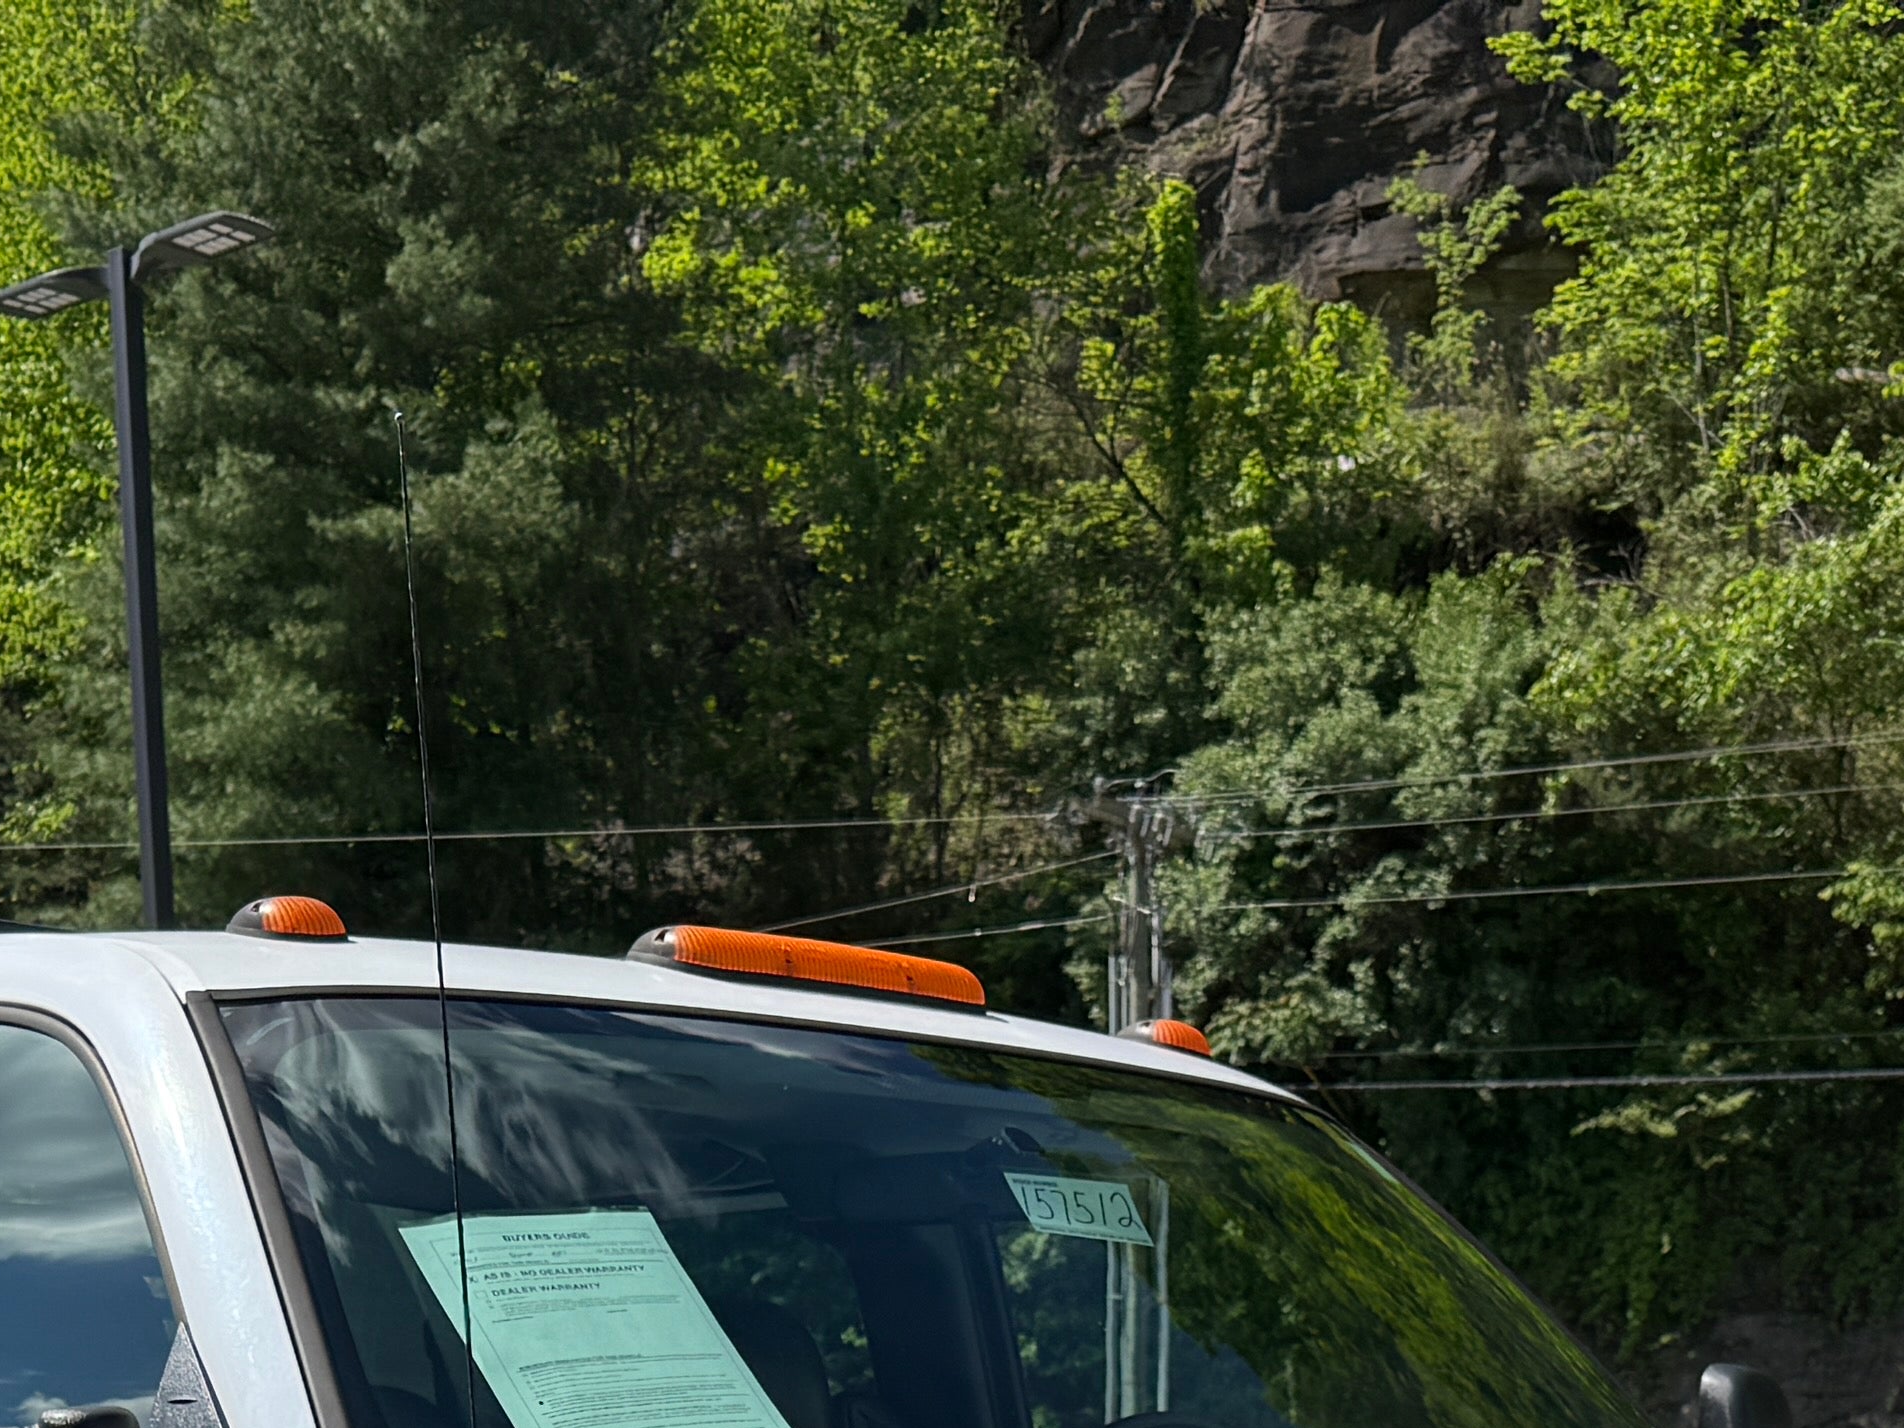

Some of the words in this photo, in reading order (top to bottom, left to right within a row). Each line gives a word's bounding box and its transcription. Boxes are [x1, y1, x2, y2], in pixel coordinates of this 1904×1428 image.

[1021, 1186, 1143, 1231] 157512
[502, 1232, 550, 1243] BUYERS
[553, 1231, 591, 1240] GUIDE
[483, 1272, 499, 1281] AS
[500, 1271, 512, 1280] IS
[520, 1269, 537, 1278] NO
[539, 1266, 583, 1277] DEALER
[584, 1264, 645, 1275] WARRANTY
[492, 1285, 537, 1297] DEALER
[539, 1282, 601, 1293] WARRANTY
